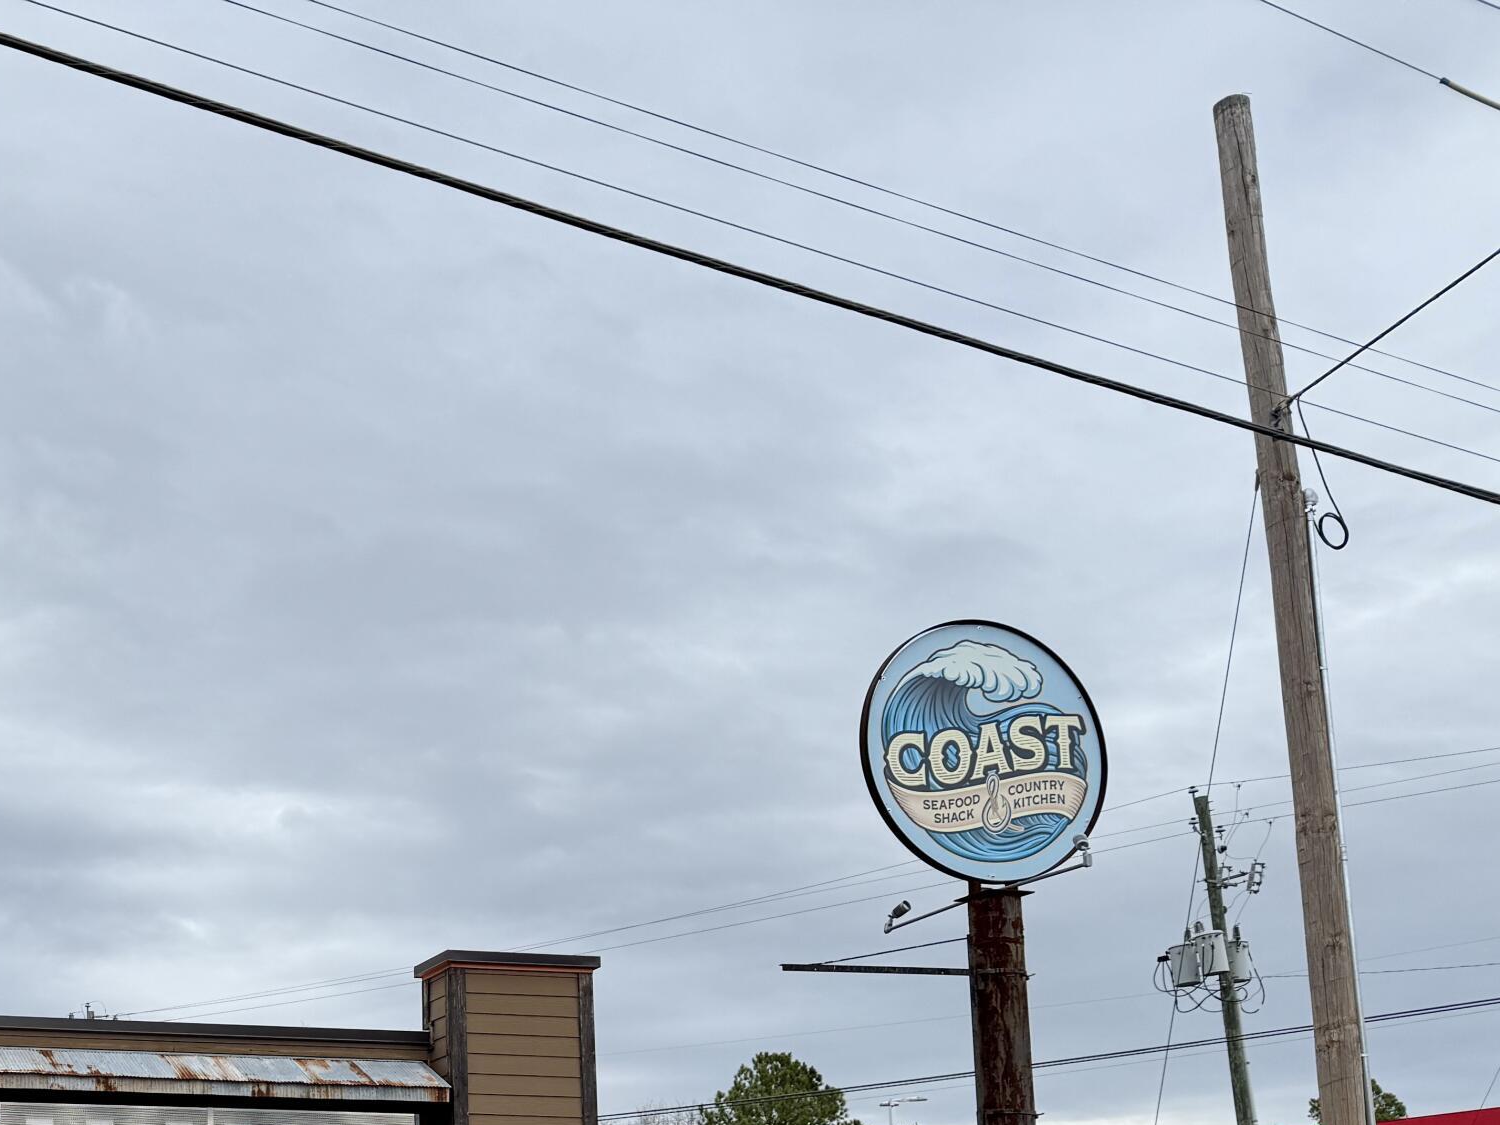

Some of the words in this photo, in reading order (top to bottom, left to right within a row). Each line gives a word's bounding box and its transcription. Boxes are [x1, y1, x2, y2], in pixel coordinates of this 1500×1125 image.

[886, 714, 1084, 788] COAST
[1008, 780, 1065, 796] COUNTRY
[923, 794, 981, 810] SEAFOOD
[1013, 794, 1066, 809] KITCHEN
[934, 809, 975, 824] SHACK
